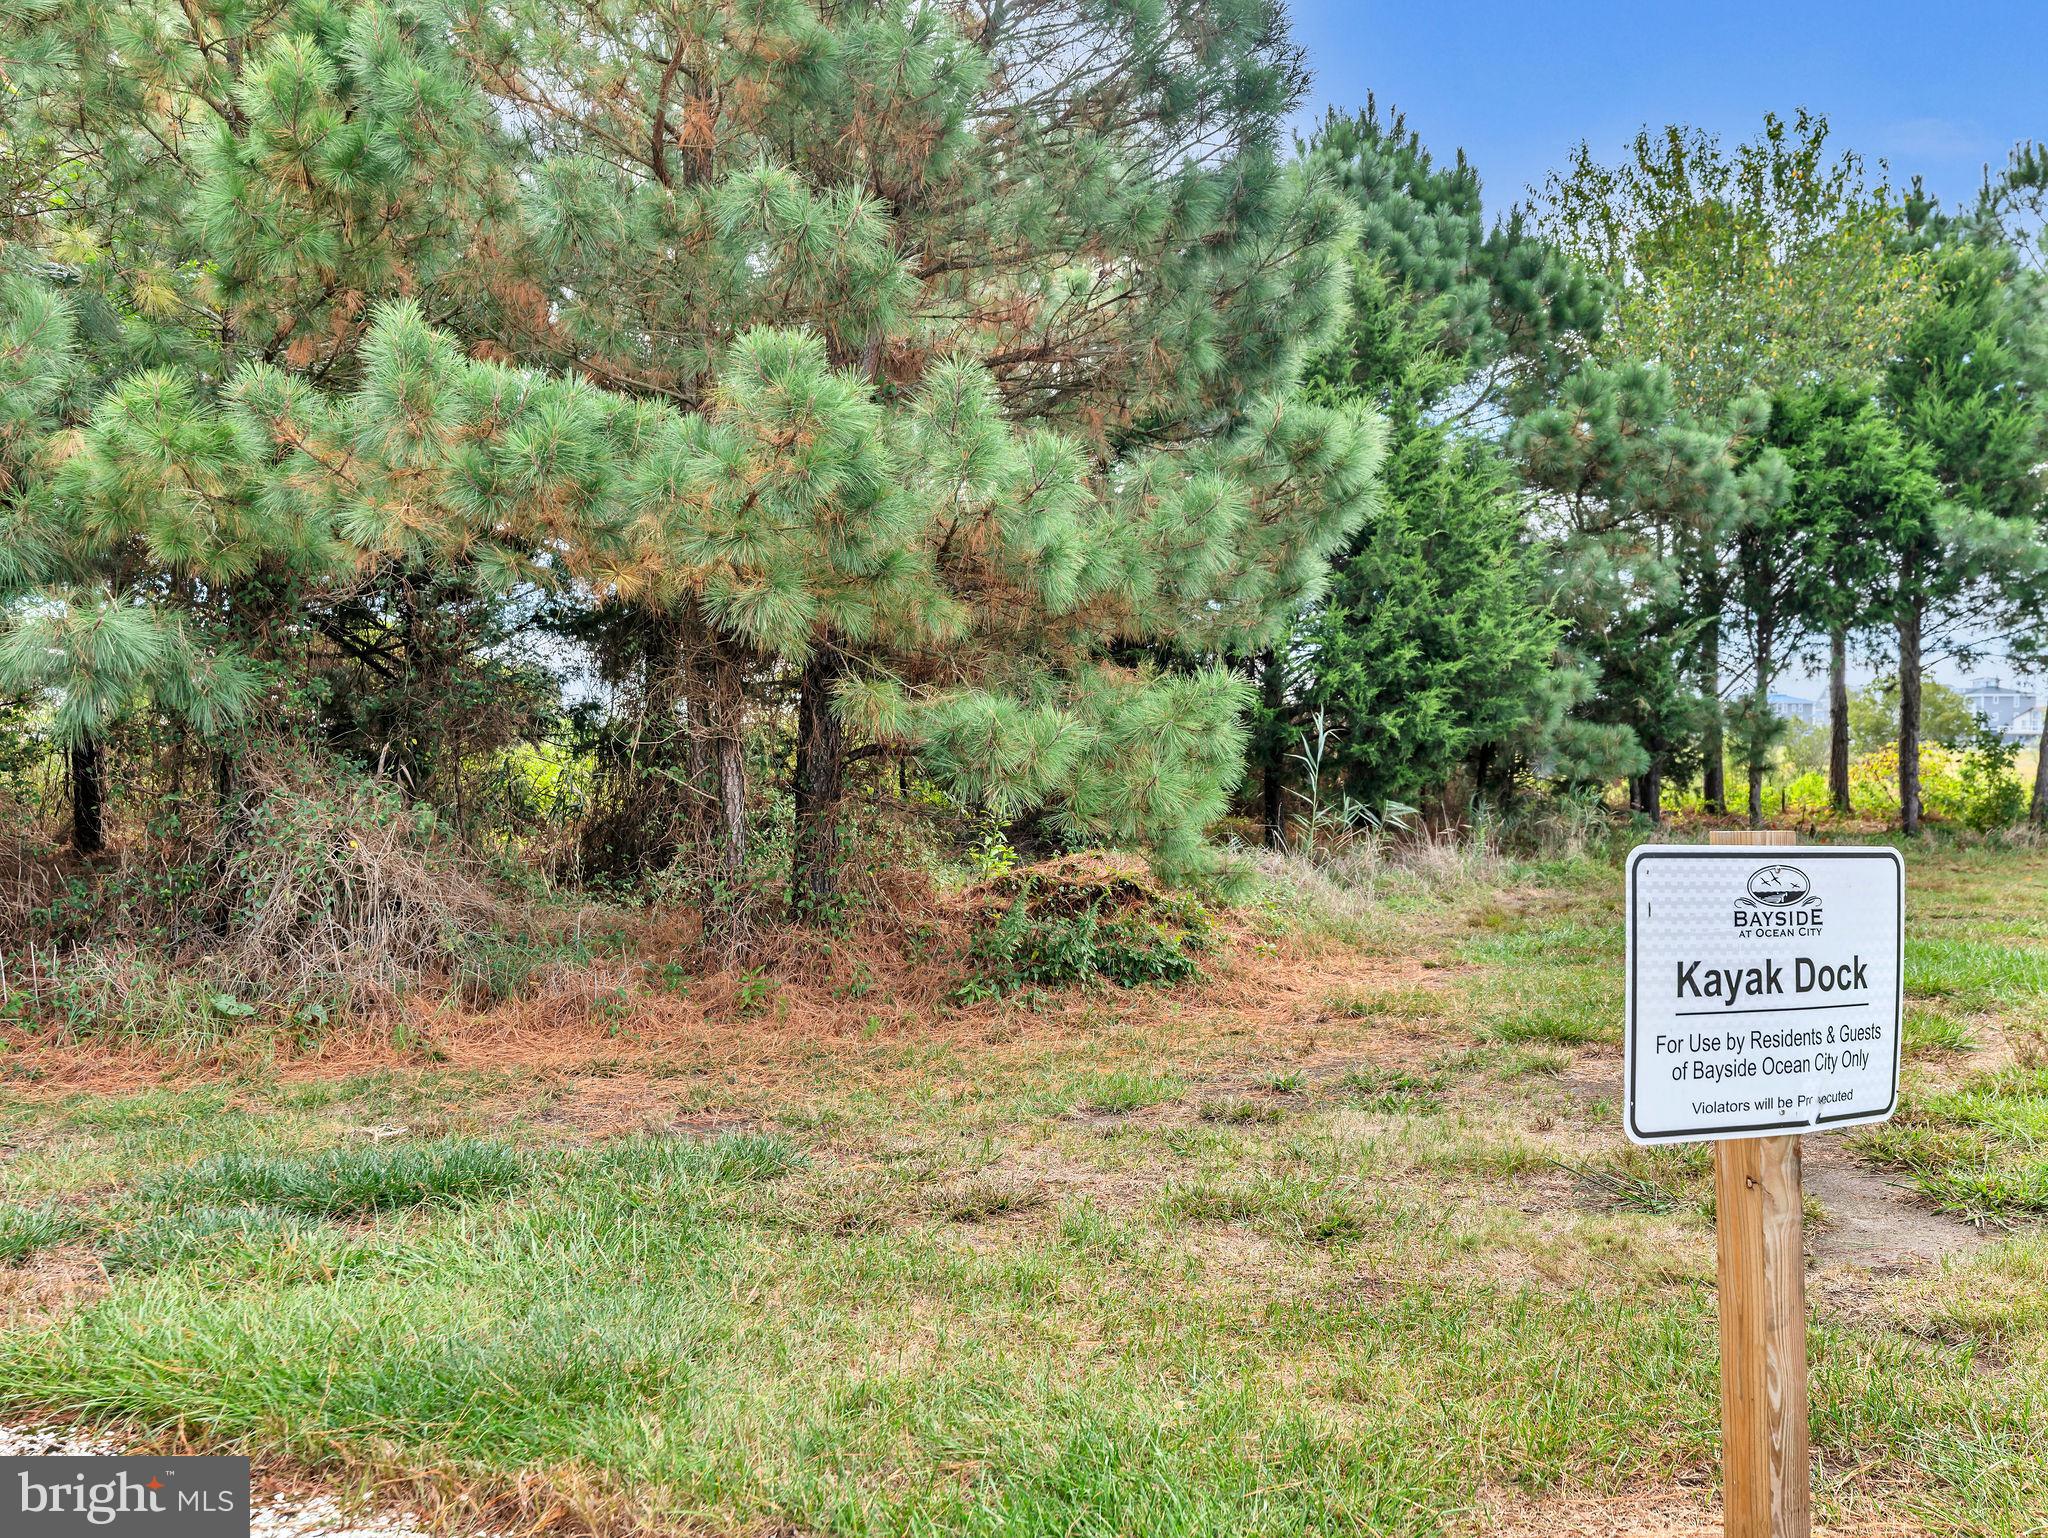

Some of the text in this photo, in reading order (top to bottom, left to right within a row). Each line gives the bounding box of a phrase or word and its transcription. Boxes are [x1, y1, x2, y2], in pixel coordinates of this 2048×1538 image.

[1734, 908, 1824, 928] BAYSIDE
[1738, 927, 1823, 938] AT OCEAN CITY
[1676, 955, 1869, 1006] Kayak Dock
[1656, 1022, 1882, 1054] For Use by Residents & Guests
[1672, 1049, 1870, 1083] of Bayside Ocean City Only
[1692, 1101, 1751, 1115] Violators
[1754, 1098, 1774, 1110] will
[1777, 1097, 1794, 1109] be
